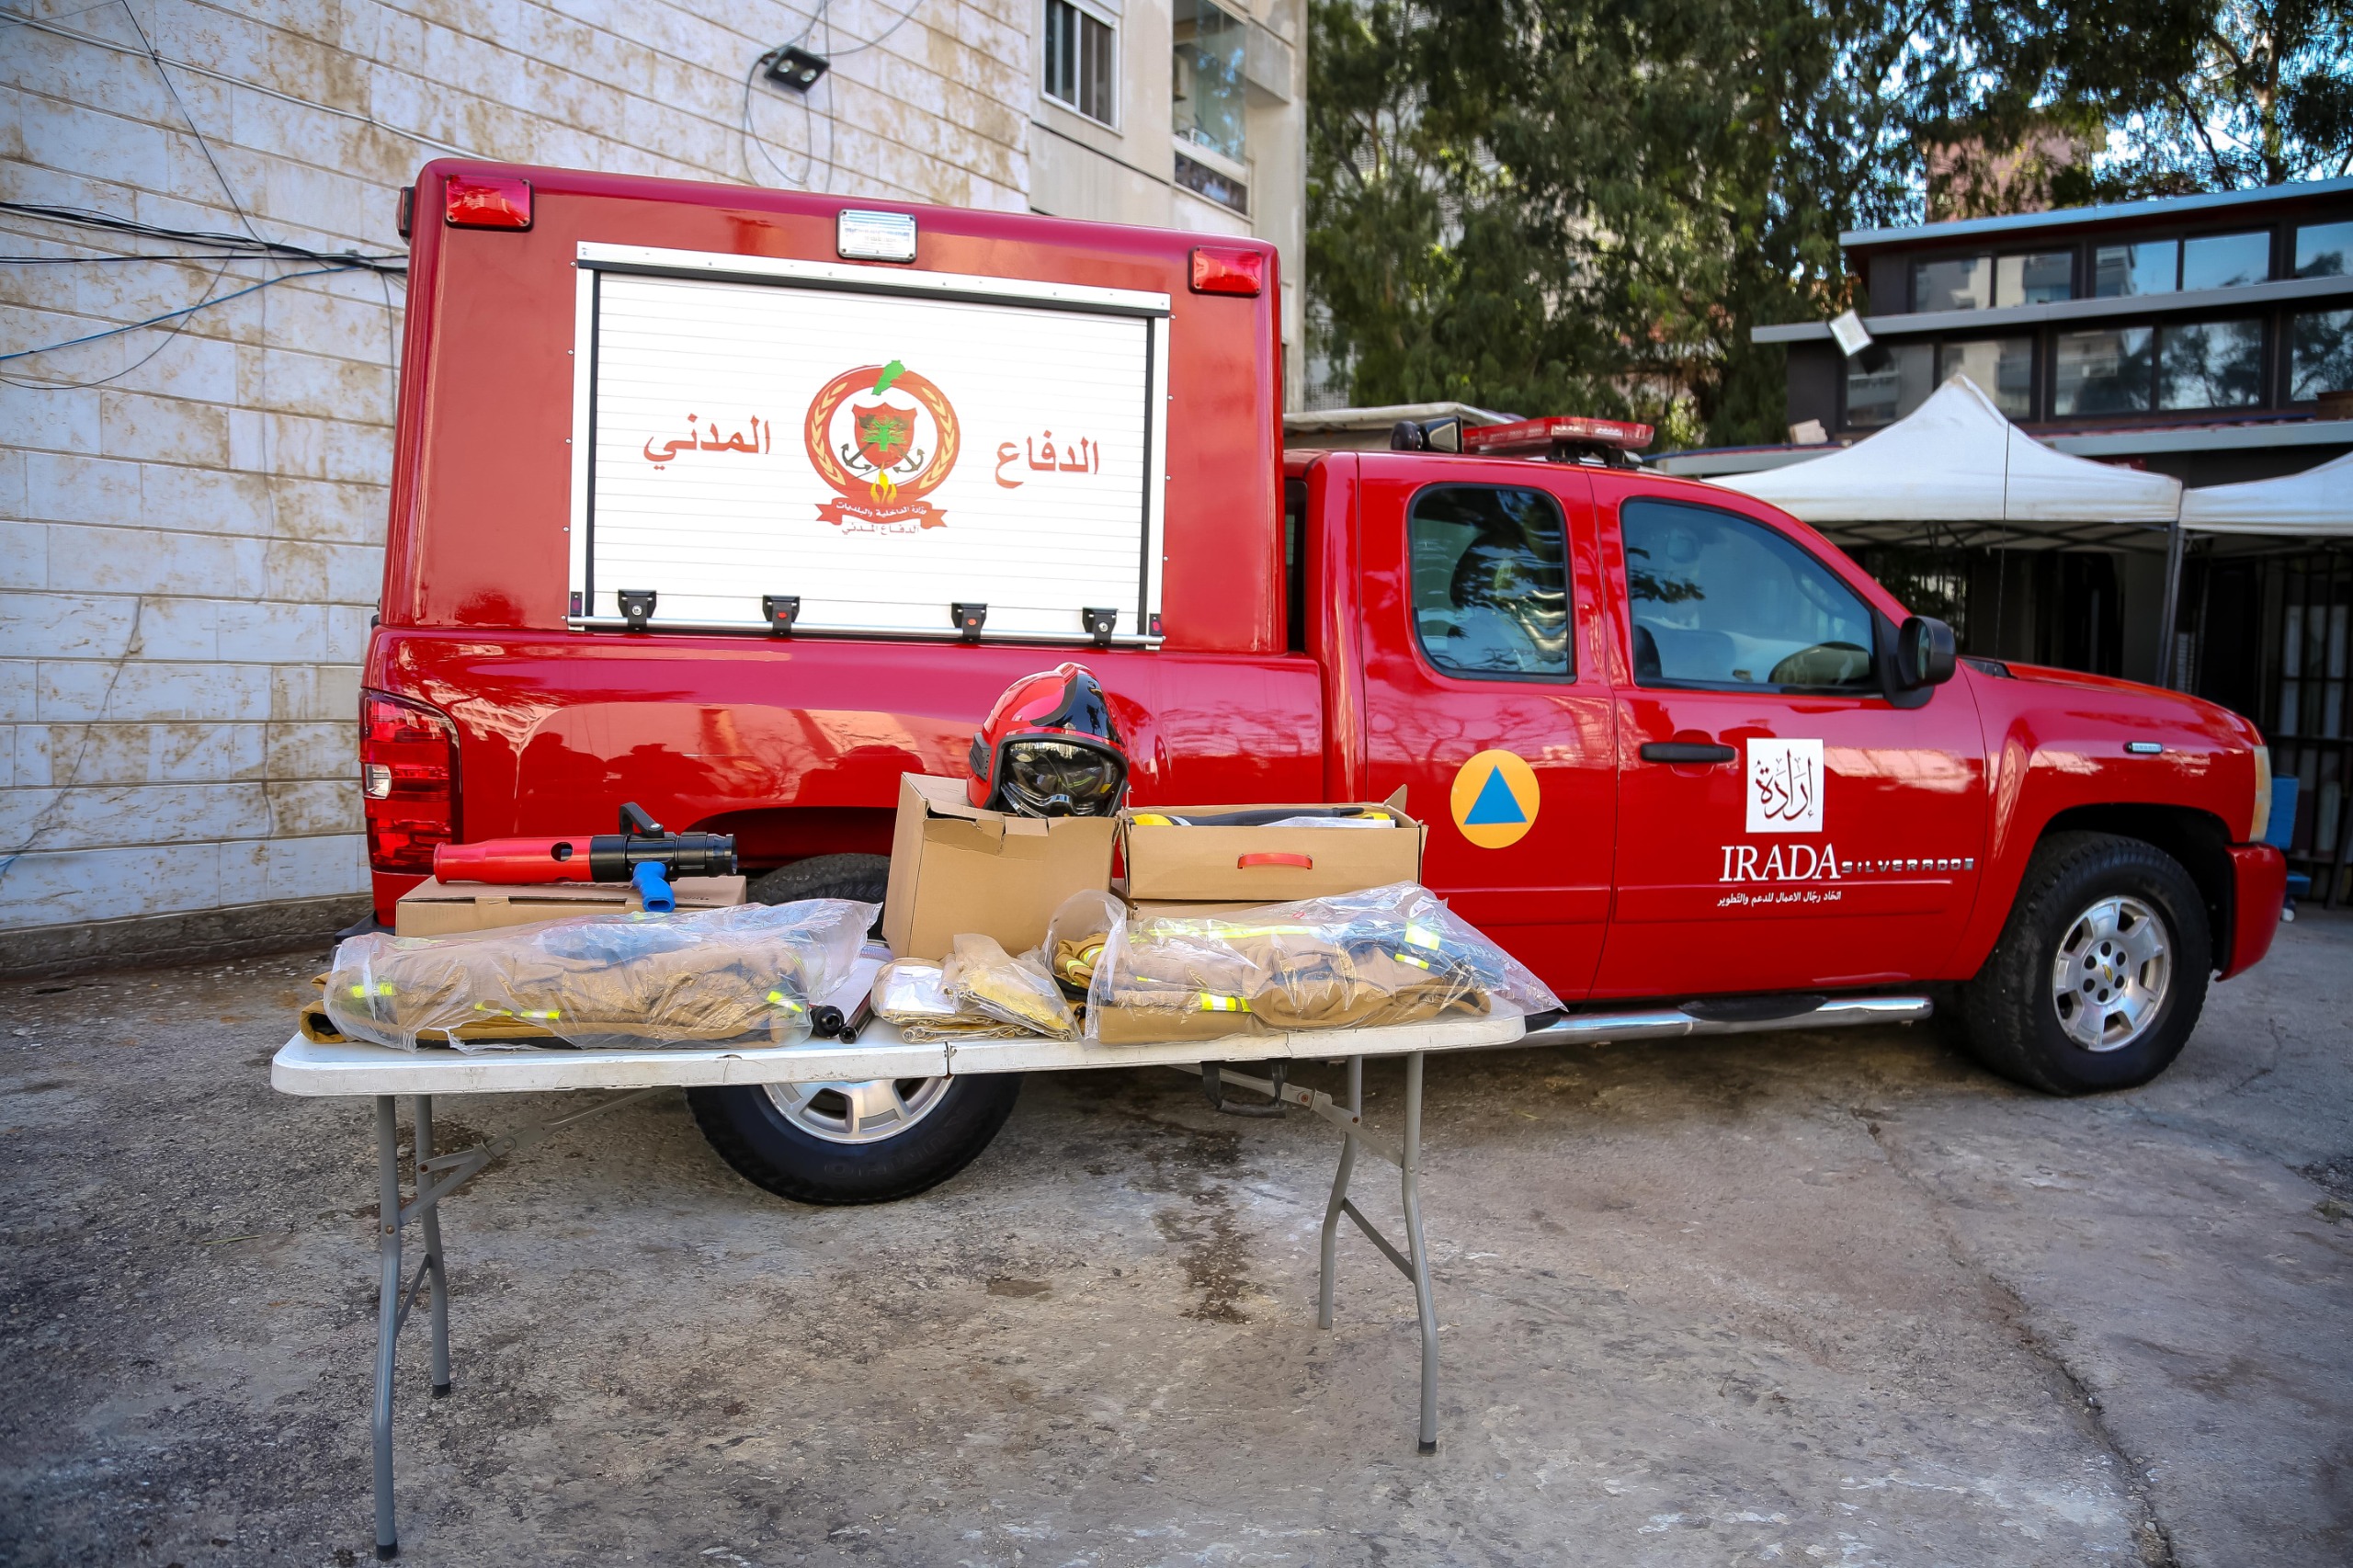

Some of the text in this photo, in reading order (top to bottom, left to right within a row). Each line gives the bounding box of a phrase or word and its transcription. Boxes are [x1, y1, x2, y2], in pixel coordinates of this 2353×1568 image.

[643, 414, 1099, 489] الدفاع المدني
[835, 502, 873, 517] والبلديات
[875, 506, 910, 517] الداخلية
[1719, 843, 1841, 882] IRADA
[1841, 858, 1961, 873] SILVERADO
[1751, 892, 1775, 907] للدعم
